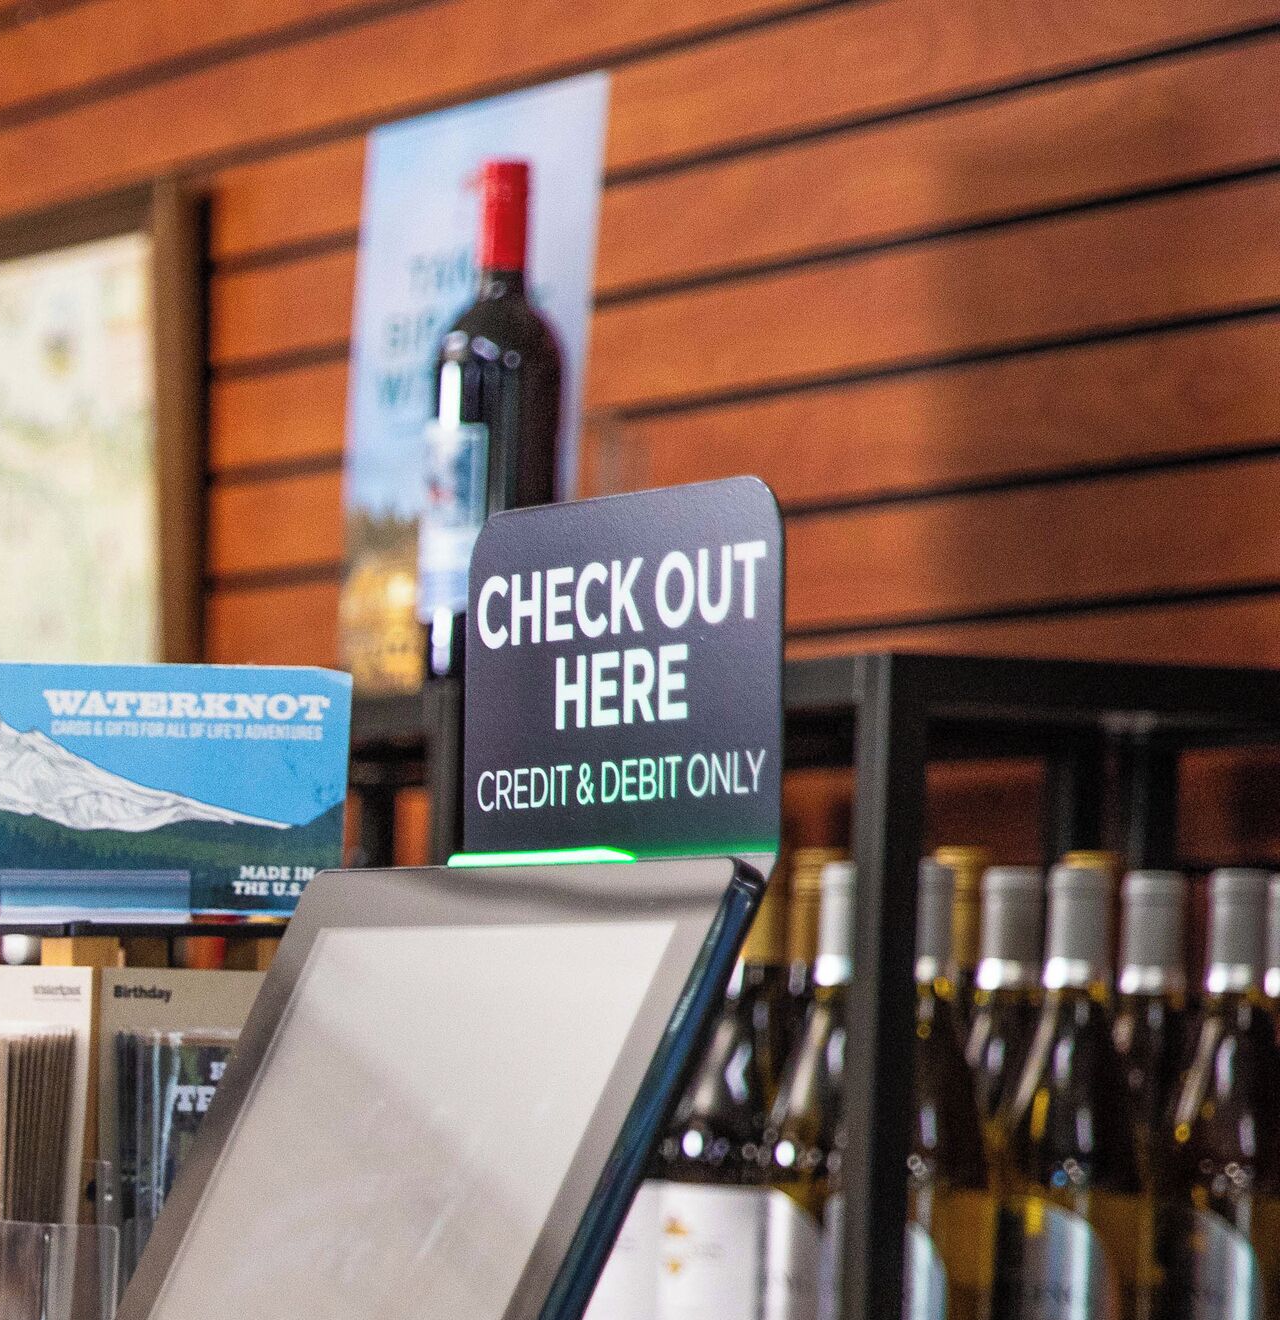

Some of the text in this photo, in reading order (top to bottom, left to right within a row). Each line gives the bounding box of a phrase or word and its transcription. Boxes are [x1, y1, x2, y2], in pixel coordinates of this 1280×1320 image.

[477, 540, 766, 649] CHECK OUT
[555, 643, 688, 730] HERE
[43, 690, 330, 721] WATERKNOT
[51, 720, 93, 736] CARDS
[105, 721, 140, 737] GIFTS
[141, 722, 165, 737] FOR
[166, 722, 186, 738] ALL
[189, 722, 204, 738] OF
[245, 723, 323, 740] ADVENTURES
[477, 749, 766, 812] CREDIT & DEBIT ONLY
[240, 865, 316, 881] MADE IN
[232, 881, 304, 897] THE U.S.
[113, 984, 173, 1003] Birthday
